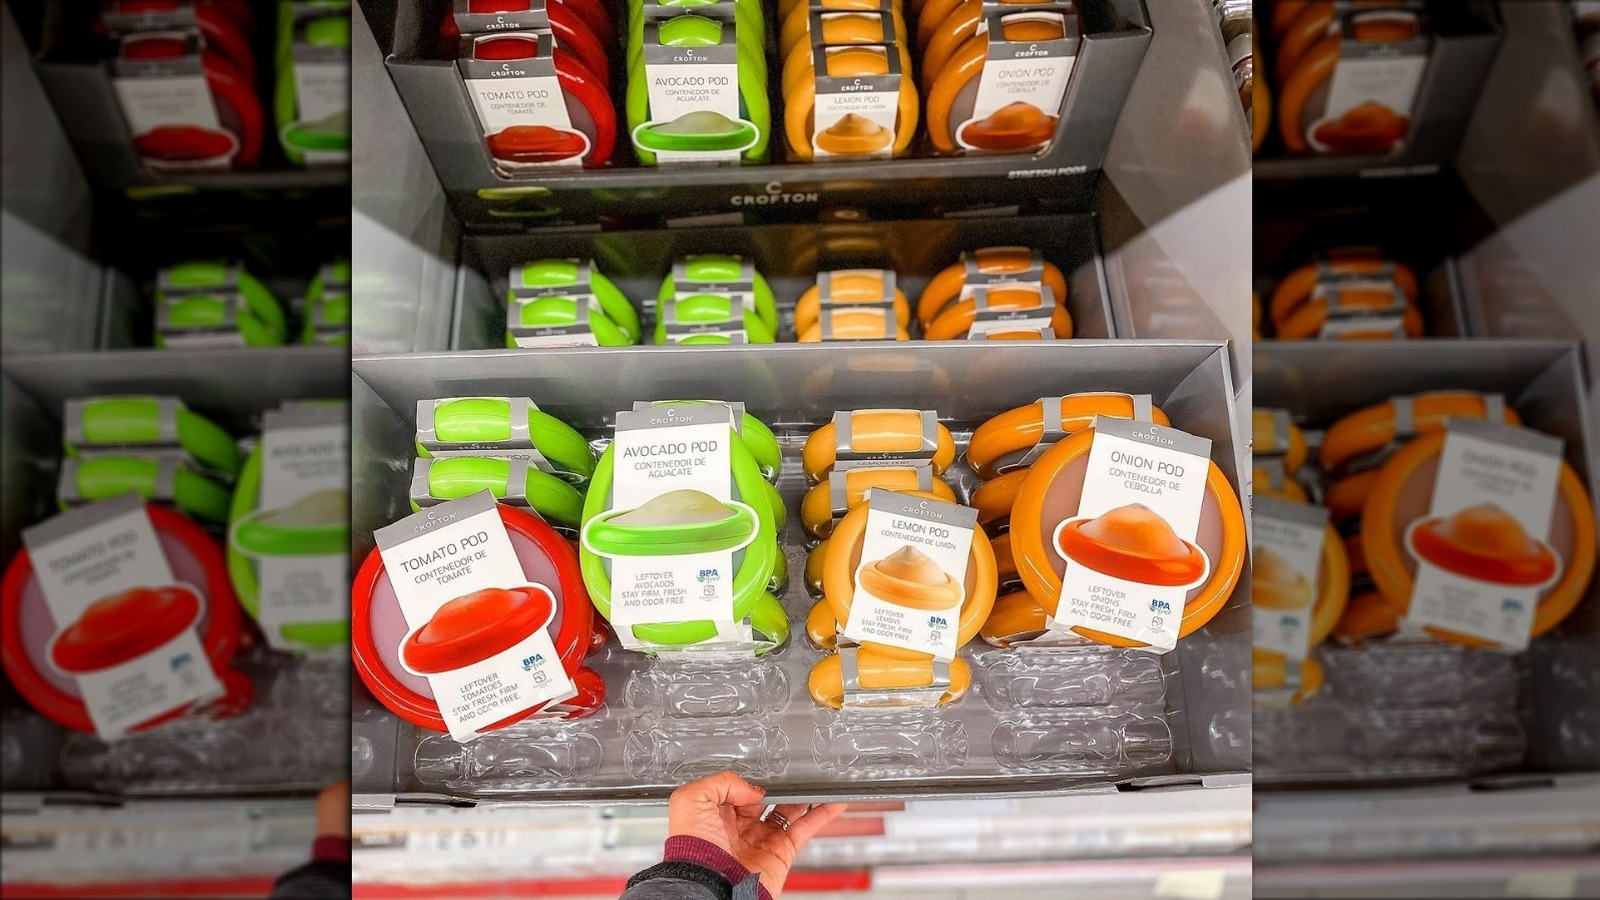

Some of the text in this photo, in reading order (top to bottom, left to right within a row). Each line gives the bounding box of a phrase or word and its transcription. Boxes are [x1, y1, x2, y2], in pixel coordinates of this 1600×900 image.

[998, 68, 1054, 79] ONION POD
[656, 76, 729, 86] AVOCADO POD
[481, 90, 549, 100] TOMATO POD
[834, 96, 861, 104] LEMON
[730, 193, 818, 206] CROFTON
[650, 416, 692, 424] CROFTON
[1132, 431, 1174, 445] CROFTON
[623, 441, 718, 458] AVOCADO POD
[635, 458, 692, 471] CONTENEDOR
[1111, 451, 1184, 477] ONION POD
[648, 468, 692, 478] AGUACATE
[1109, 468, 1181, 491] CONTENEDOR DE
[1124, 481, 1162, 495] CEBOLLA
[903, 506, 942, 519] CROFTON
[413, 513, 456, 533] CROFTON
[892, 520, 950, 538] LEMON POD
[881, 529, 924, 543] CONTENEDOR
[925, 537, 935, 545] DE
[400, 531, 489, 573] TOMATO POD
[414, 550, 487, 584] CONTENEDOR DE
[700, 569, 718, 577] BPA
[436, 565, 472, 586] TOMATE
[636, 572, 673, 580] LEFTOVER
[634, 580, 675, 589] AVOCADOS
[622, 590, 639, 598] STAY
[663, 588, 687, 596] FRESH
[1088, 584, 1126, 600] LEFTOVER
[624, 598, 640, 607] AND
[642, 597, 664, 606] ODOR
[1091, 594, 1119, 607] ONIONS
[1151, 599, 1170, 611] BPA
[874, 608, 905, 618] LEFTOVER
[1071, 598, 1089, 609] STAY
[1118, 608, 1137, 620] FIRM
[861, 619, 876, 627] STAY
[876, 615, 901, 625] LEMONS
[930, 616, 947, 626] BPA
[1090, 611, 1112, 622] ODOR
[523, 654, 543, 666] BPA
[460, 672, 499, 693] LEFTOVER
[462, 682, 503, 701] TOMATOES
[452, 703, 471, 717] STAY
[500, 683, 519, 696] FIRM
[459, 711, 476, 723] AND
[477, 701, 499, 715] ODOR
